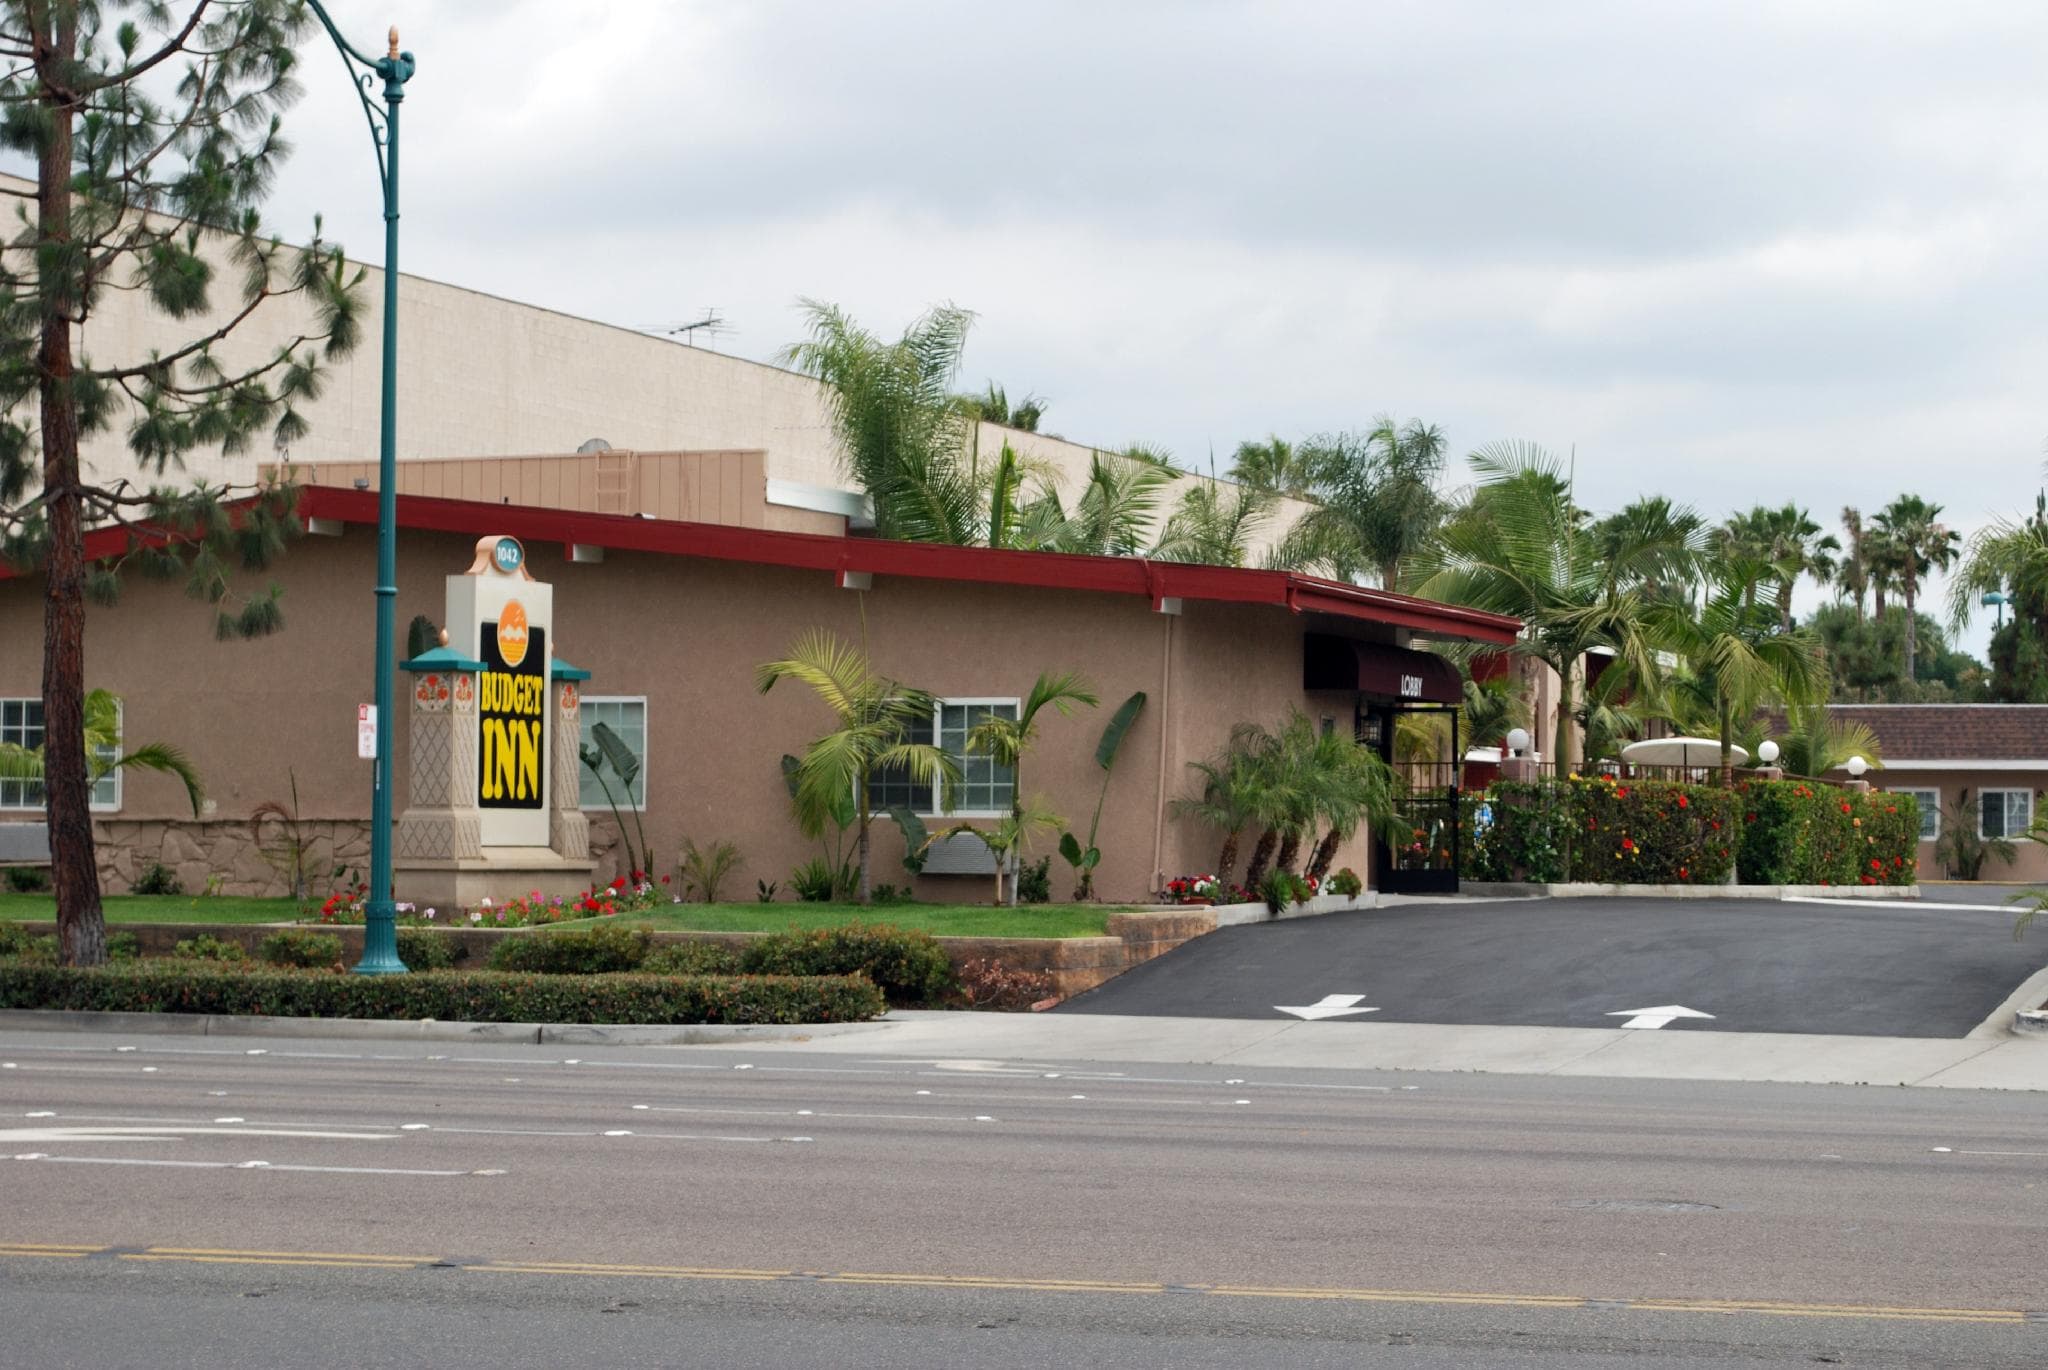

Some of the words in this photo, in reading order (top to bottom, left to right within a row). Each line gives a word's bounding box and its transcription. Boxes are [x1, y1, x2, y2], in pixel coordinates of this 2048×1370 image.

[497, 546, 518, 563] 1042
[481, 671, 543, 715] BUDGET
[1401, 674, 1423, 697] LOBBY
[481, 717, 541, 801] INN
